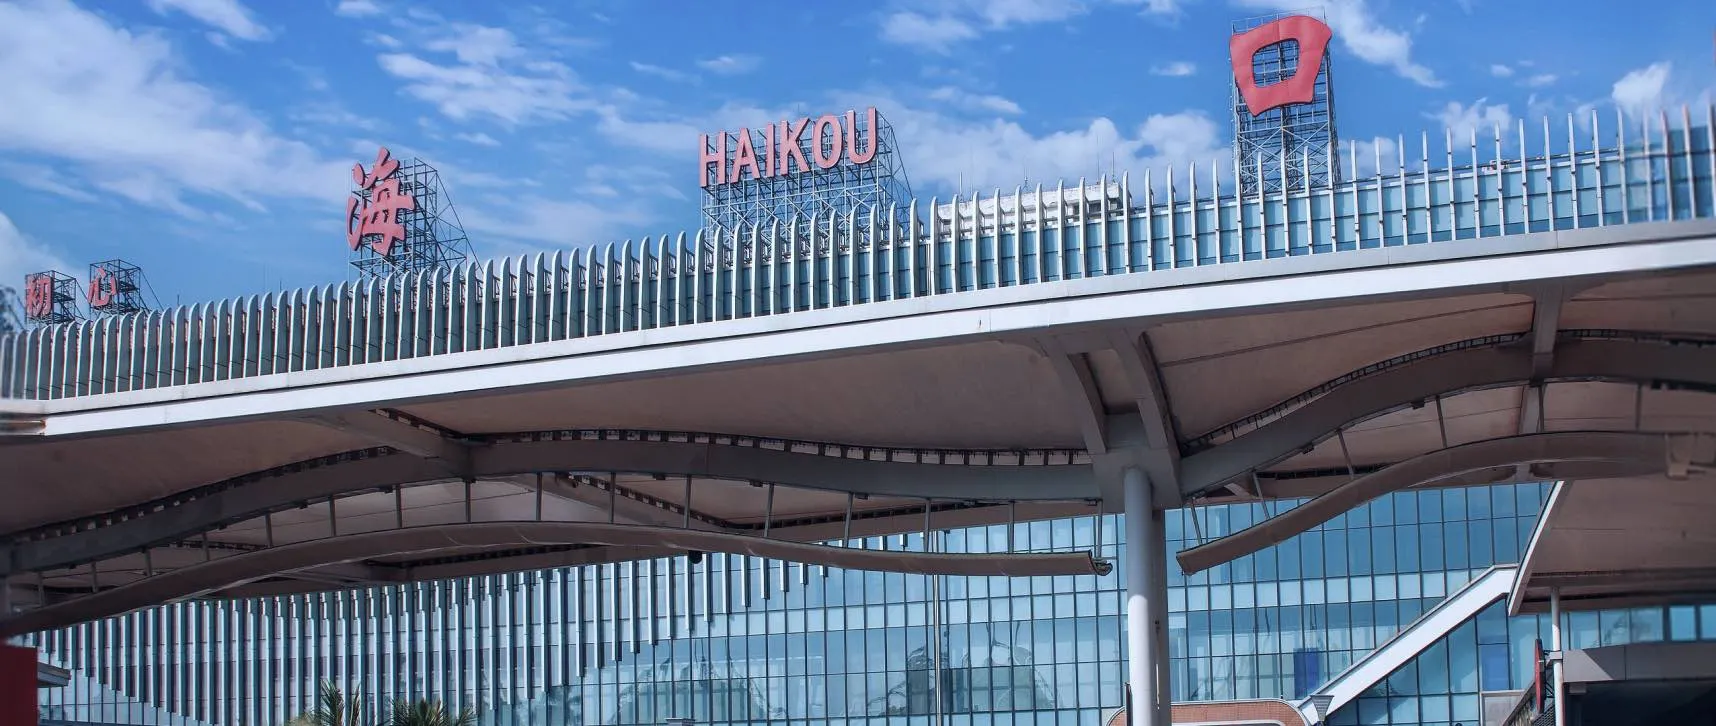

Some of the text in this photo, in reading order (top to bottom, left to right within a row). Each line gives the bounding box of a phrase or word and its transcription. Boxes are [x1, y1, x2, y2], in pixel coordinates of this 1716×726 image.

[1229, 15, 1332, 117] 口
[700, 107, 877, 187] HAIKOU
[346, 146, 416, 256] 海
